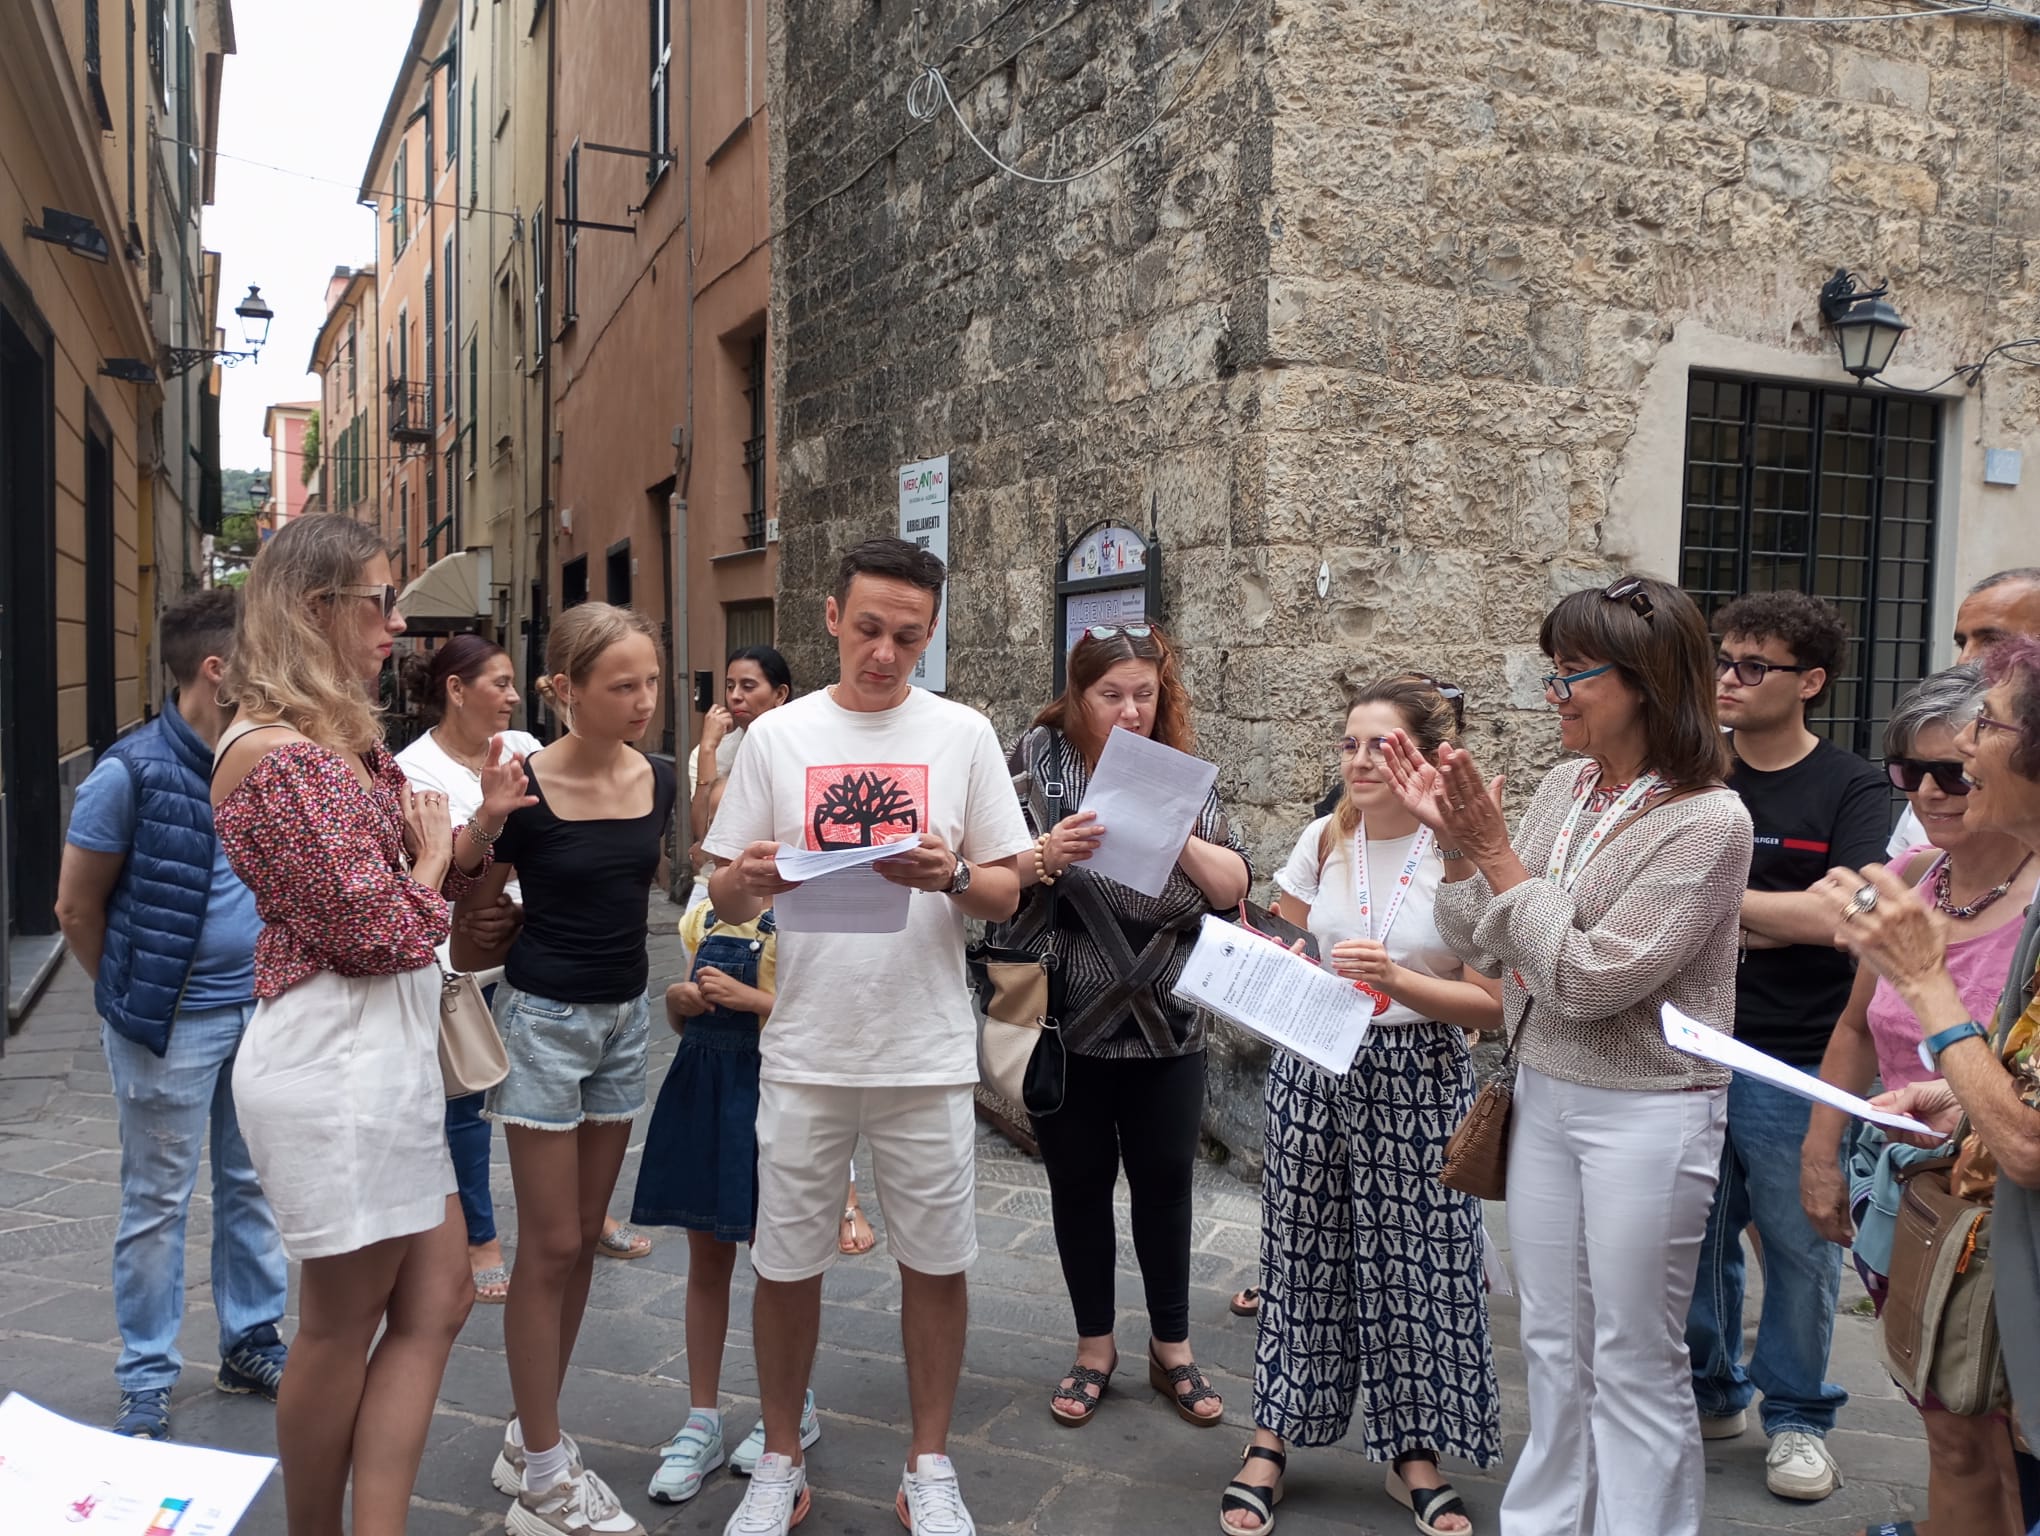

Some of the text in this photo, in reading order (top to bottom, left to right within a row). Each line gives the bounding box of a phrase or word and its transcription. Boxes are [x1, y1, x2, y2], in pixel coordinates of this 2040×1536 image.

[903, 470, 944, 493] MERCANTINO
[906, 515, 940, 533] ABBIGLIAMENTO
[1069, 599, 1120, 625] ALBENGA
[1753, 836, 1780, 845] ILFIGER
[1403, 860, 1417, 876] FAI
[1359, 890, 1369, 905] FAI
